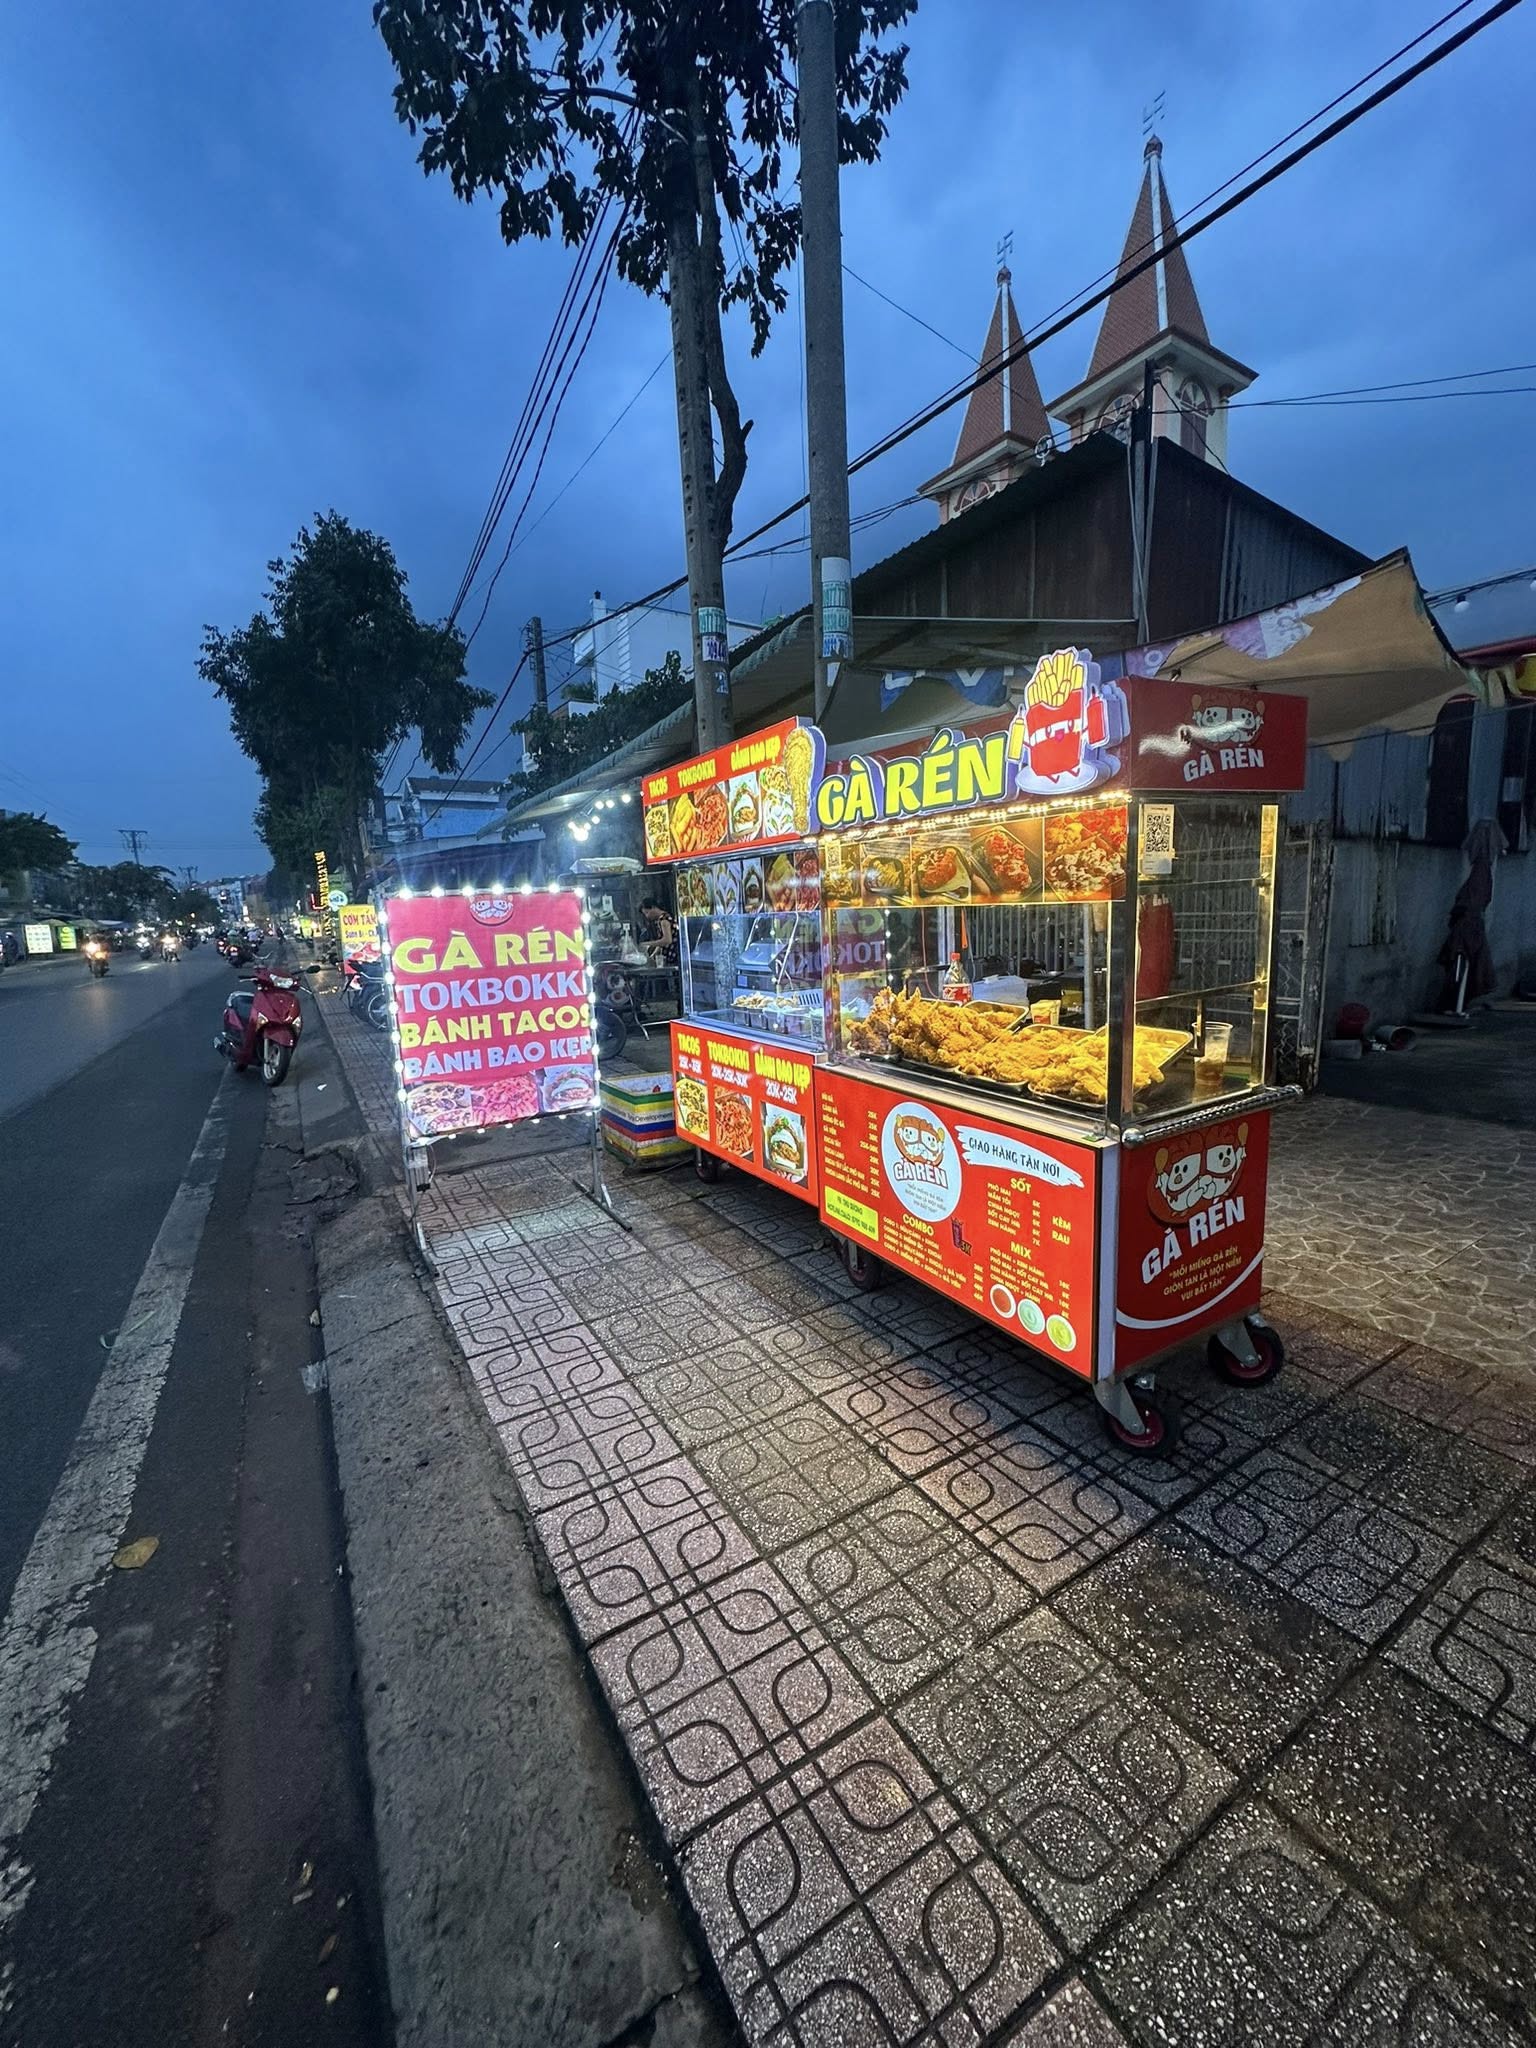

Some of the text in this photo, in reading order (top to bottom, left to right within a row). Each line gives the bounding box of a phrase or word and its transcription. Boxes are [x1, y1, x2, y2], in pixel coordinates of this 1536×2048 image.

[1183, 744, 1265, 782] GÀ RÉN
[648, 776, 668, 798] TACOS
[817, 731, 1007, 827] GÀ RÉN
[394, 926, 584, 973] GÀ RÉN
[399, 969, 587, 1013] TOKBOKK
[400, 1003, 592, 1049] BÁNH TACOS
[404, 1036, 592, 1080] BÁNH BAO KẸP
[677, 1032, 700, 1057] TACOS
[707, 1040, 750, 1072] TOKBOKKI
[969, 1137, 990, 1153] GIAO
[992, 1144, 1018, 1164] HÀNG
[1043, 1161, 1060, 1178] NƠI
[893, 1157, 949, 1190] GÀ RÉN
[1010, 1178, 1032, 1194] SỐT
[1000, 1187, 1011, 1197] MAI
[903, 1214, 934, 1236] COMBO
[1052, 1216, 1071, 1231] KÈM
[1010, 1241, 1032, 1260] MIX
[1052, 1230, 1070, 1245] RAU
[1142, 1196, 1245, 1284] GÀ RÉN
[1213, 1250, 1223, 1261] GÀ
[1185, 1275, 1198, 1286] TAN
[1200, 1269, 1208, 1280] LÀ
[1181, 1290, 1193, 1301] VUI
